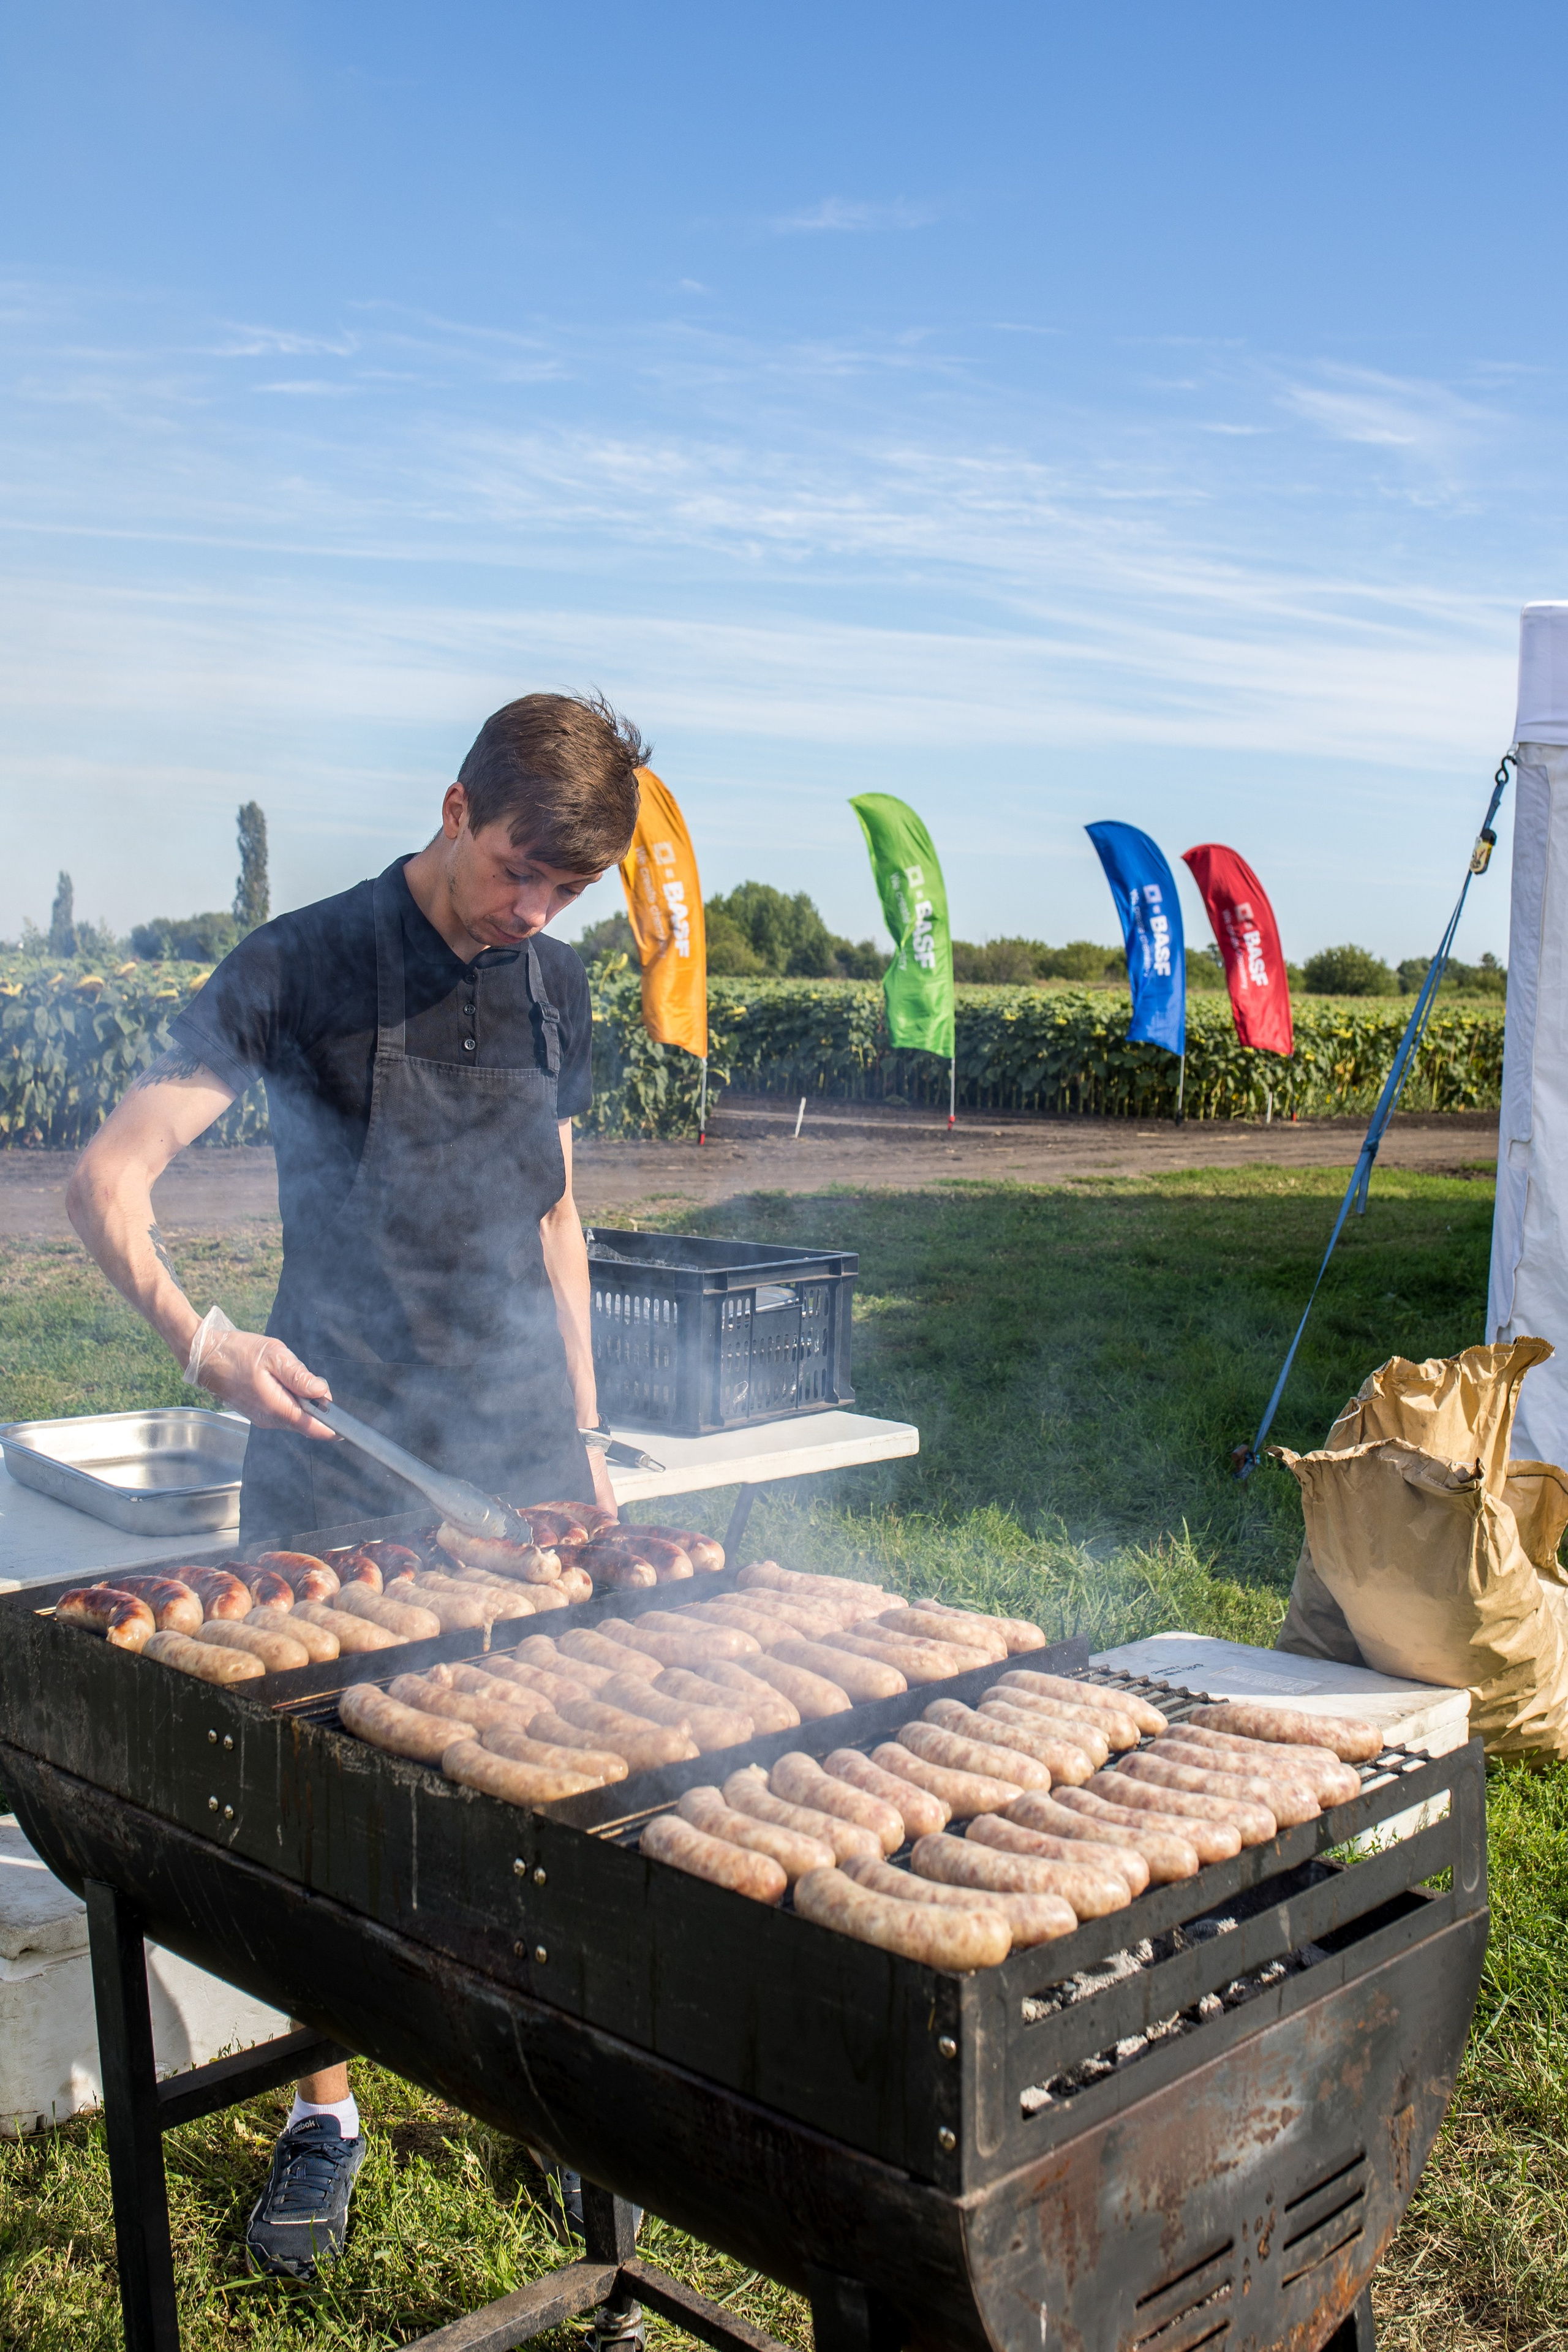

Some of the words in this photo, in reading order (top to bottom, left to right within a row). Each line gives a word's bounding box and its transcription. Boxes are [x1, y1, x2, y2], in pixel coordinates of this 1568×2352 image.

[640, 867, 657, 903] create
[662, 881, 690, 957] BASF
[913, 900, 935, 969] BASF
[1150, 915, 1171, 976] BASF
[1243, 930, 1268, 986] BASF
